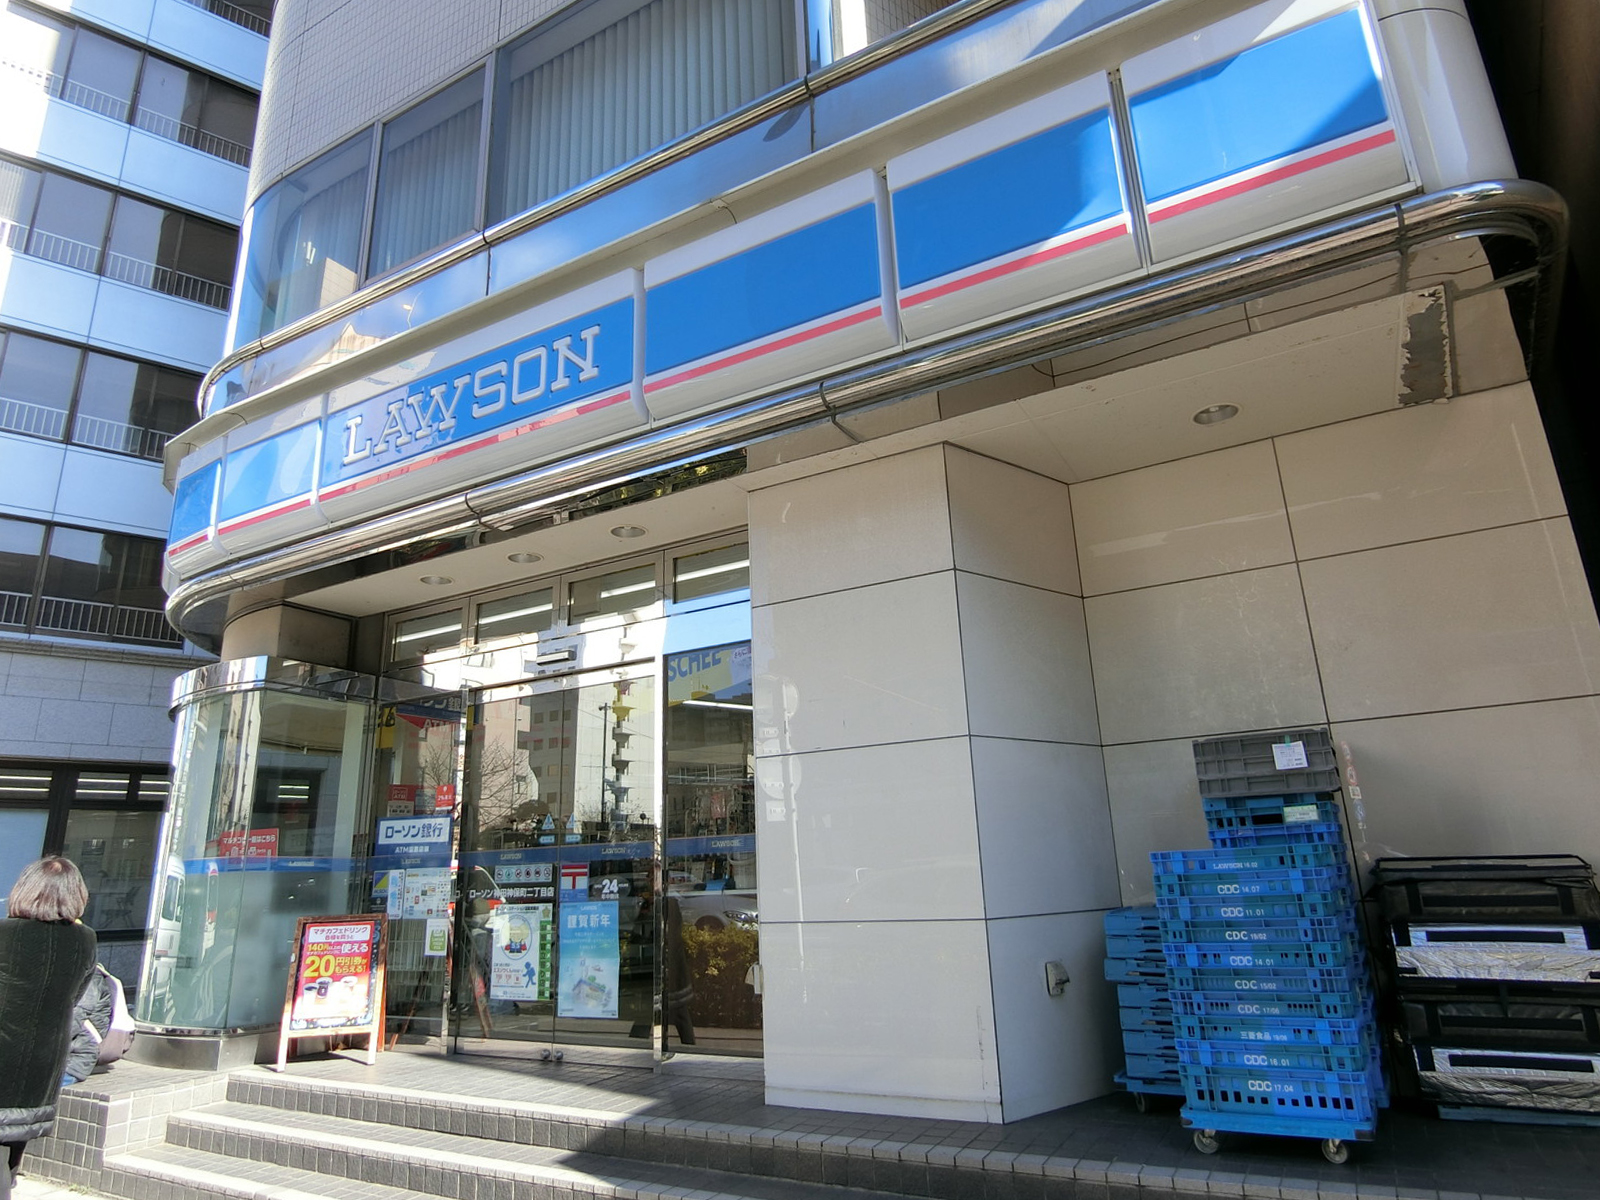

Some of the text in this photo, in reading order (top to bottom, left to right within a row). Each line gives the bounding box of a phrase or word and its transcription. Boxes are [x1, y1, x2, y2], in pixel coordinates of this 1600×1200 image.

[343, 324, 600, 466] LAWSON
[385, 823, 443, 839] ローソン銀行
[601, 878, 619, 893] 24
[1217, 884, 1240, 894] CDC
[469, 886, 555, 899] ローソン神田神保町二丁目店
[1220, 907, 1244, 917] CDC
[313, 926, 368, 936] マチカフェドリンク
[1225, 931, 1248, 940] CDC
[341, 943, 369, 954] 使える
[1229, 955, 1252, 966] CDC
[303, 955, 336, 978] 20
[1234, 980, 1257, 989] CDC
[1237, 1004, 1261, 1014] CDC
[1243, 1054, 1268, 1065] CDC
[1247, 1080, 1272, 1091] CDC
